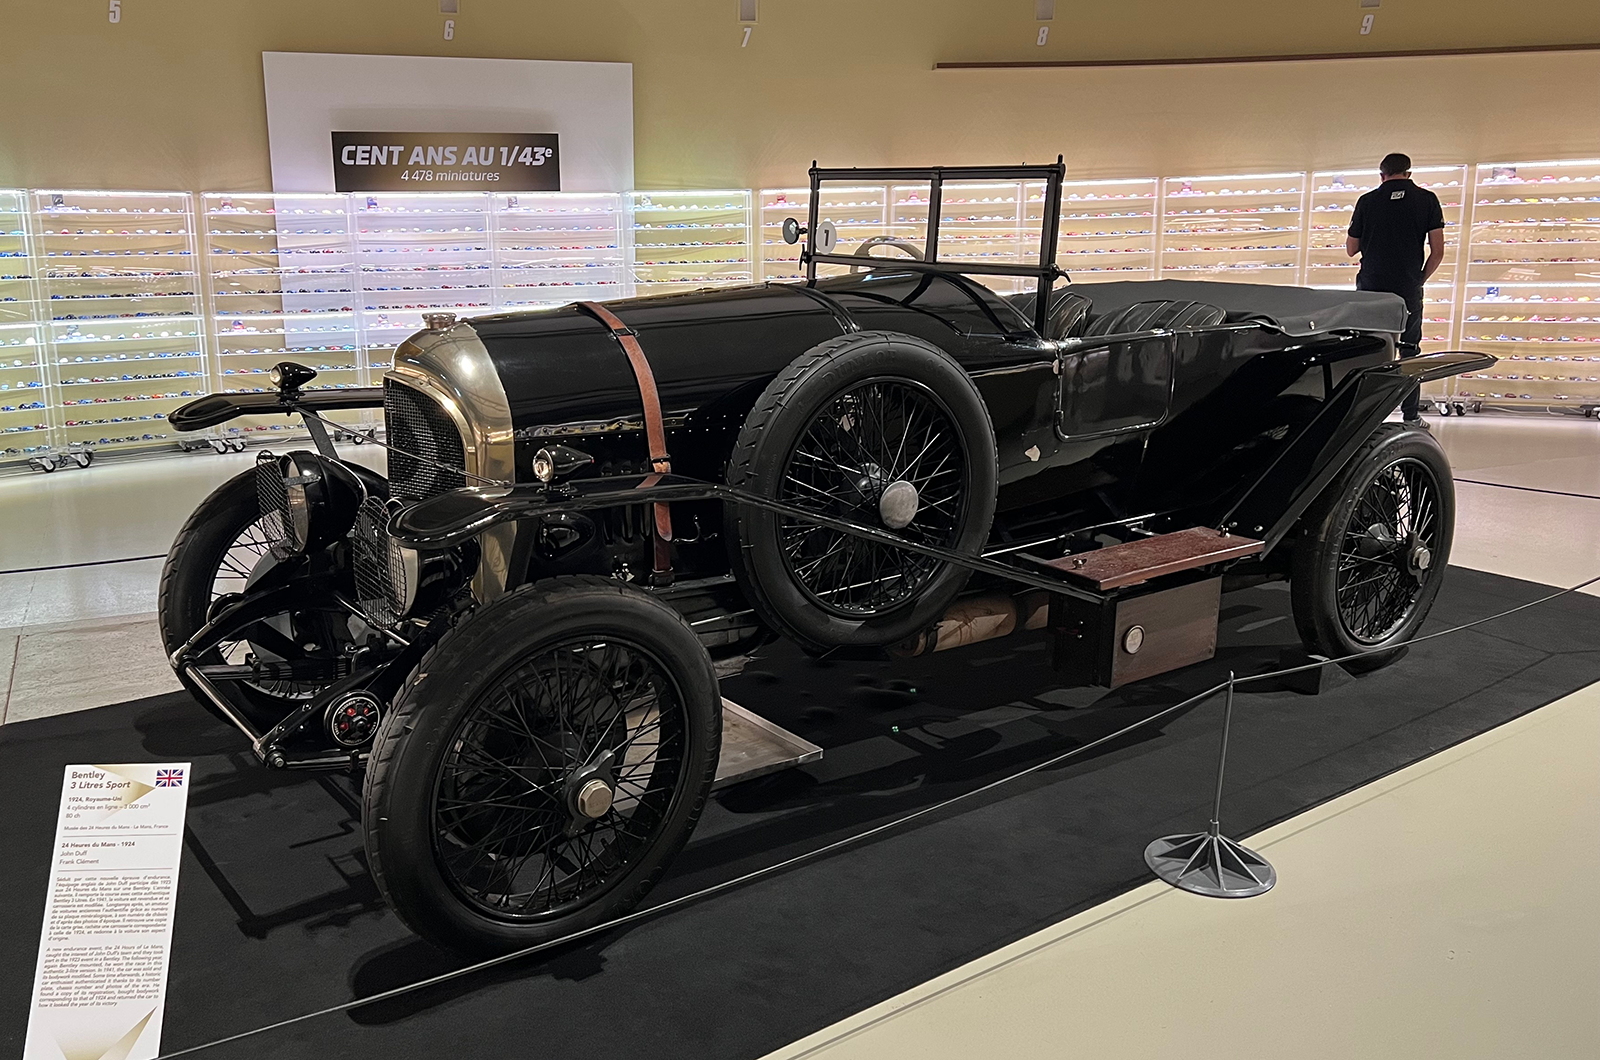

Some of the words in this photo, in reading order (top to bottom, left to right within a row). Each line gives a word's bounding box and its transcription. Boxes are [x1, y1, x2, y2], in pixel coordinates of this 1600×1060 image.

[109, 0, 121, 23] 5
[444, 20, 455, 40] 6
[1360, 14, 1374, 34] 9
[742, 27, 752, 47] 7
[1036, 26, 1049, 46] 8
[341, 145, 404, 166] CENT
[408, 146, 457, 166] ANS
[461, 146, 494, 166] AU
[401, 170, 409, 180] 4
[412, 170, 432, 180] 478
[436, 170, 500, 181] miniatures
[71, 770, 105, 780] Bentley
[105, 780, 130, 790] Sport
